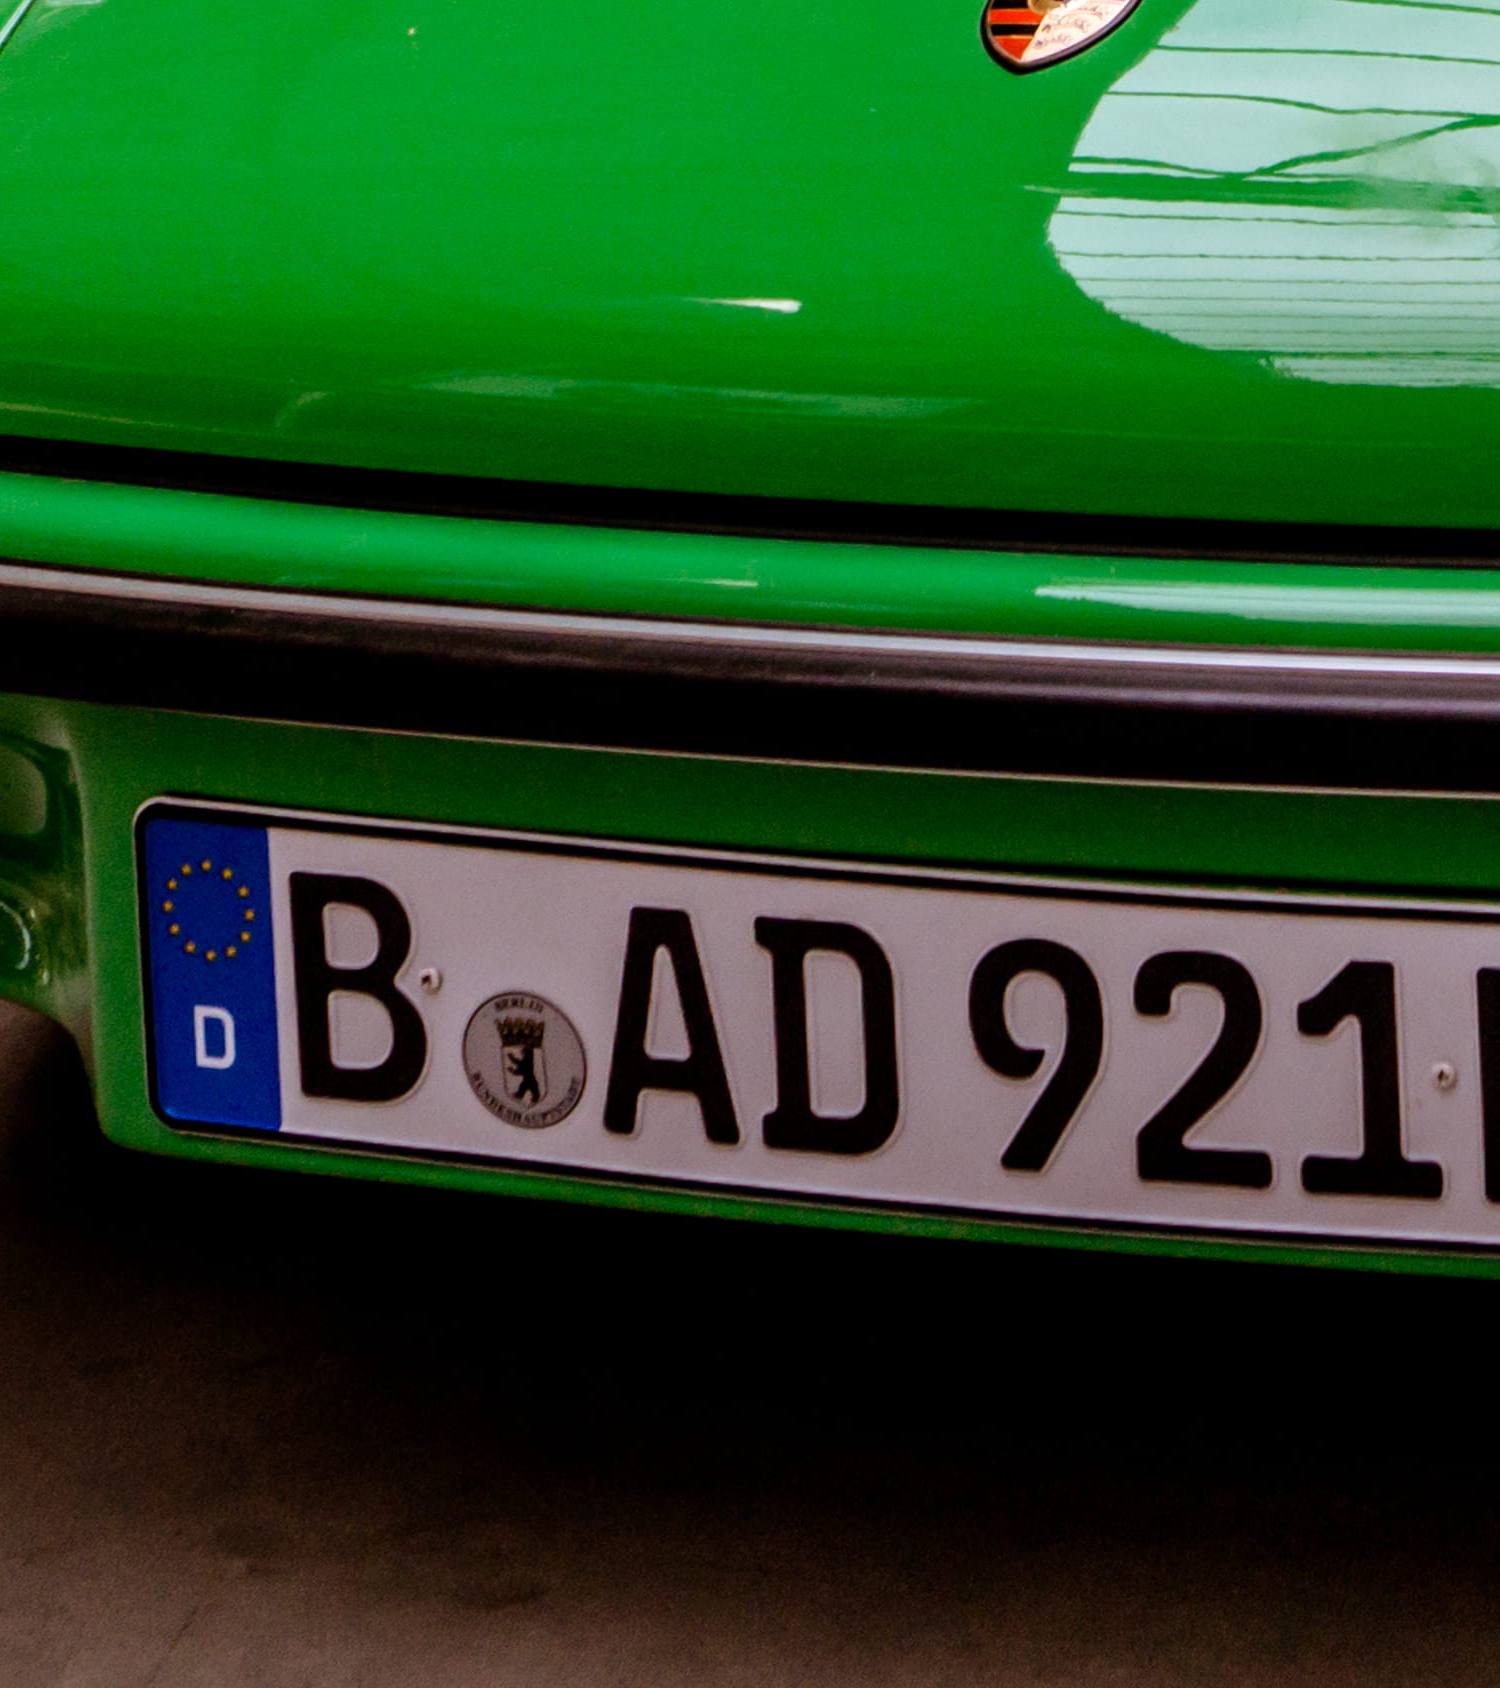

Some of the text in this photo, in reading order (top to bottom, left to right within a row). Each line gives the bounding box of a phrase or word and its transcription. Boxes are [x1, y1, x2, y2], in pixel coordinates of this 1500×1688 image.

[193, 1004, 237, 1070] D
[289, 871, 428, 1102] B
[603, 906, 901, 1156] AD
